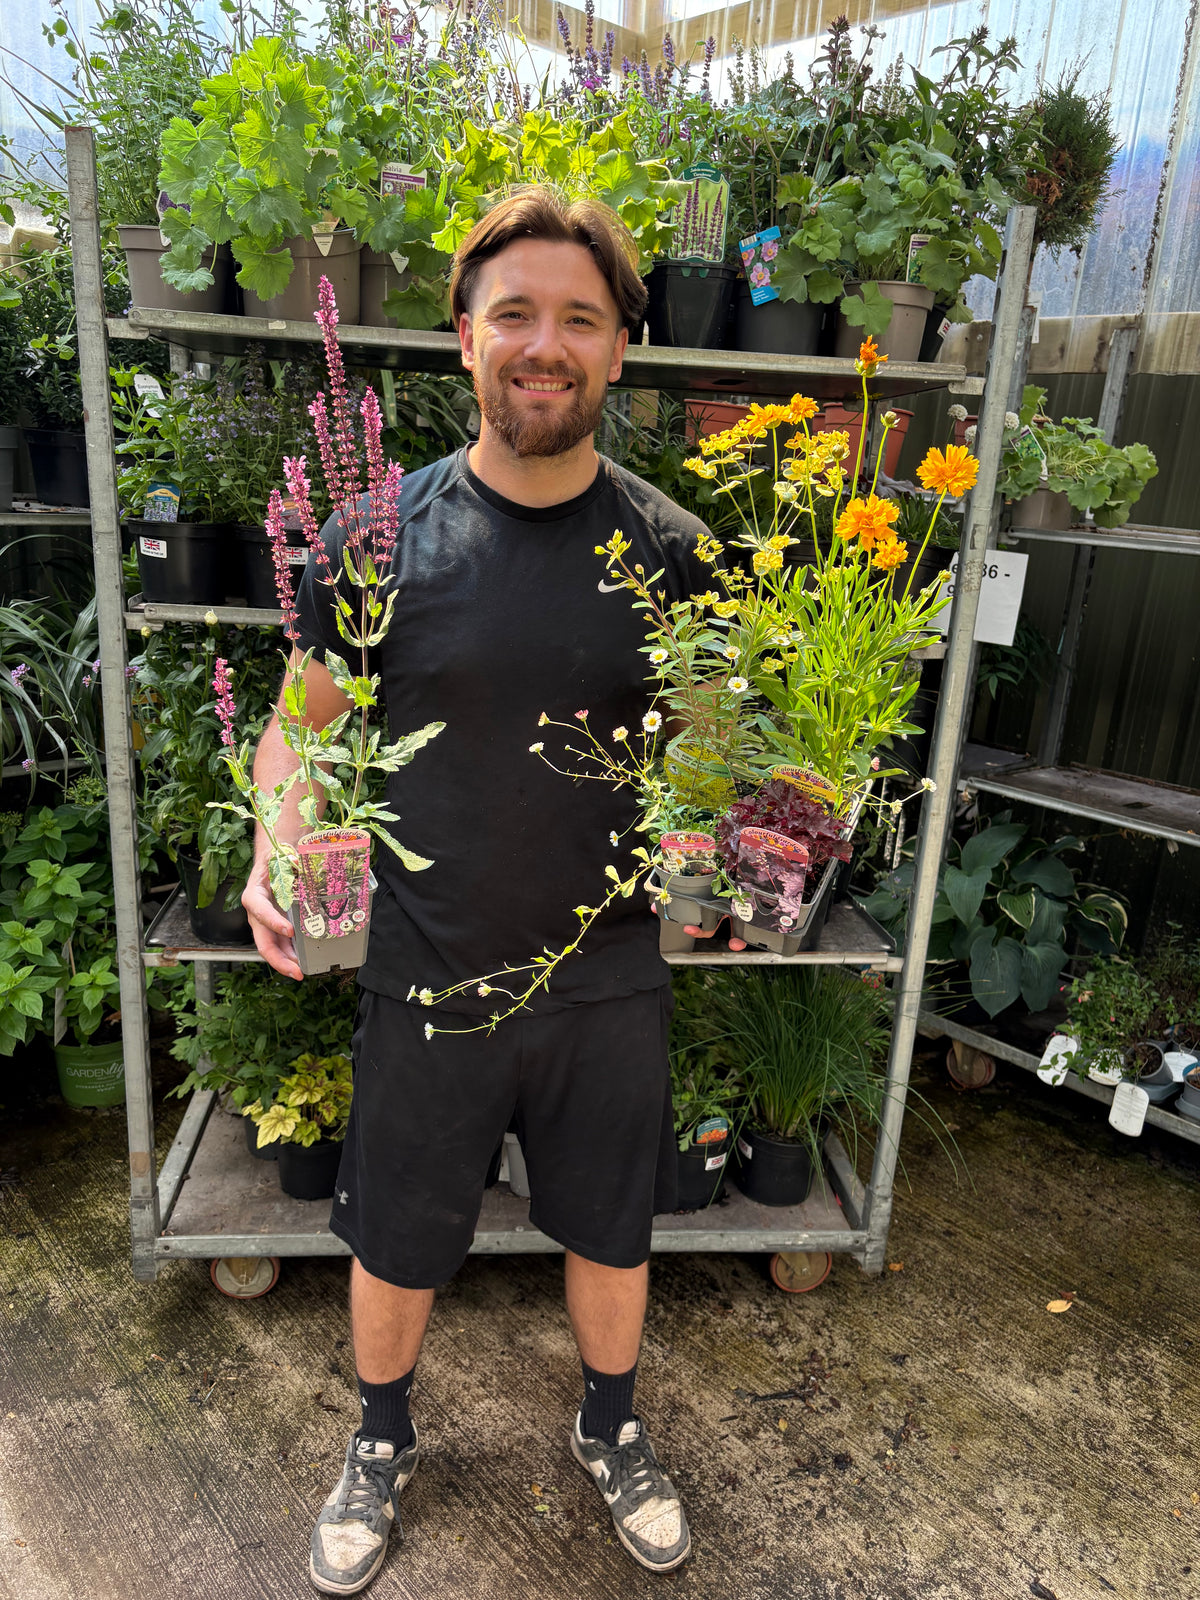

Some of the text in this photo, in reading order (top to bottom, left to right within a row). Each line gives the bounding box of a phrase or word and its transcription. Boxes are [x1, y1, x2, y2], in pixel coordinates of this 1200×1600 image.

[776, 766, 808, 776] Colourful
[302, 830, 368, 845] Colourful Gardens
[743, 829, 777, 841] Colourful
